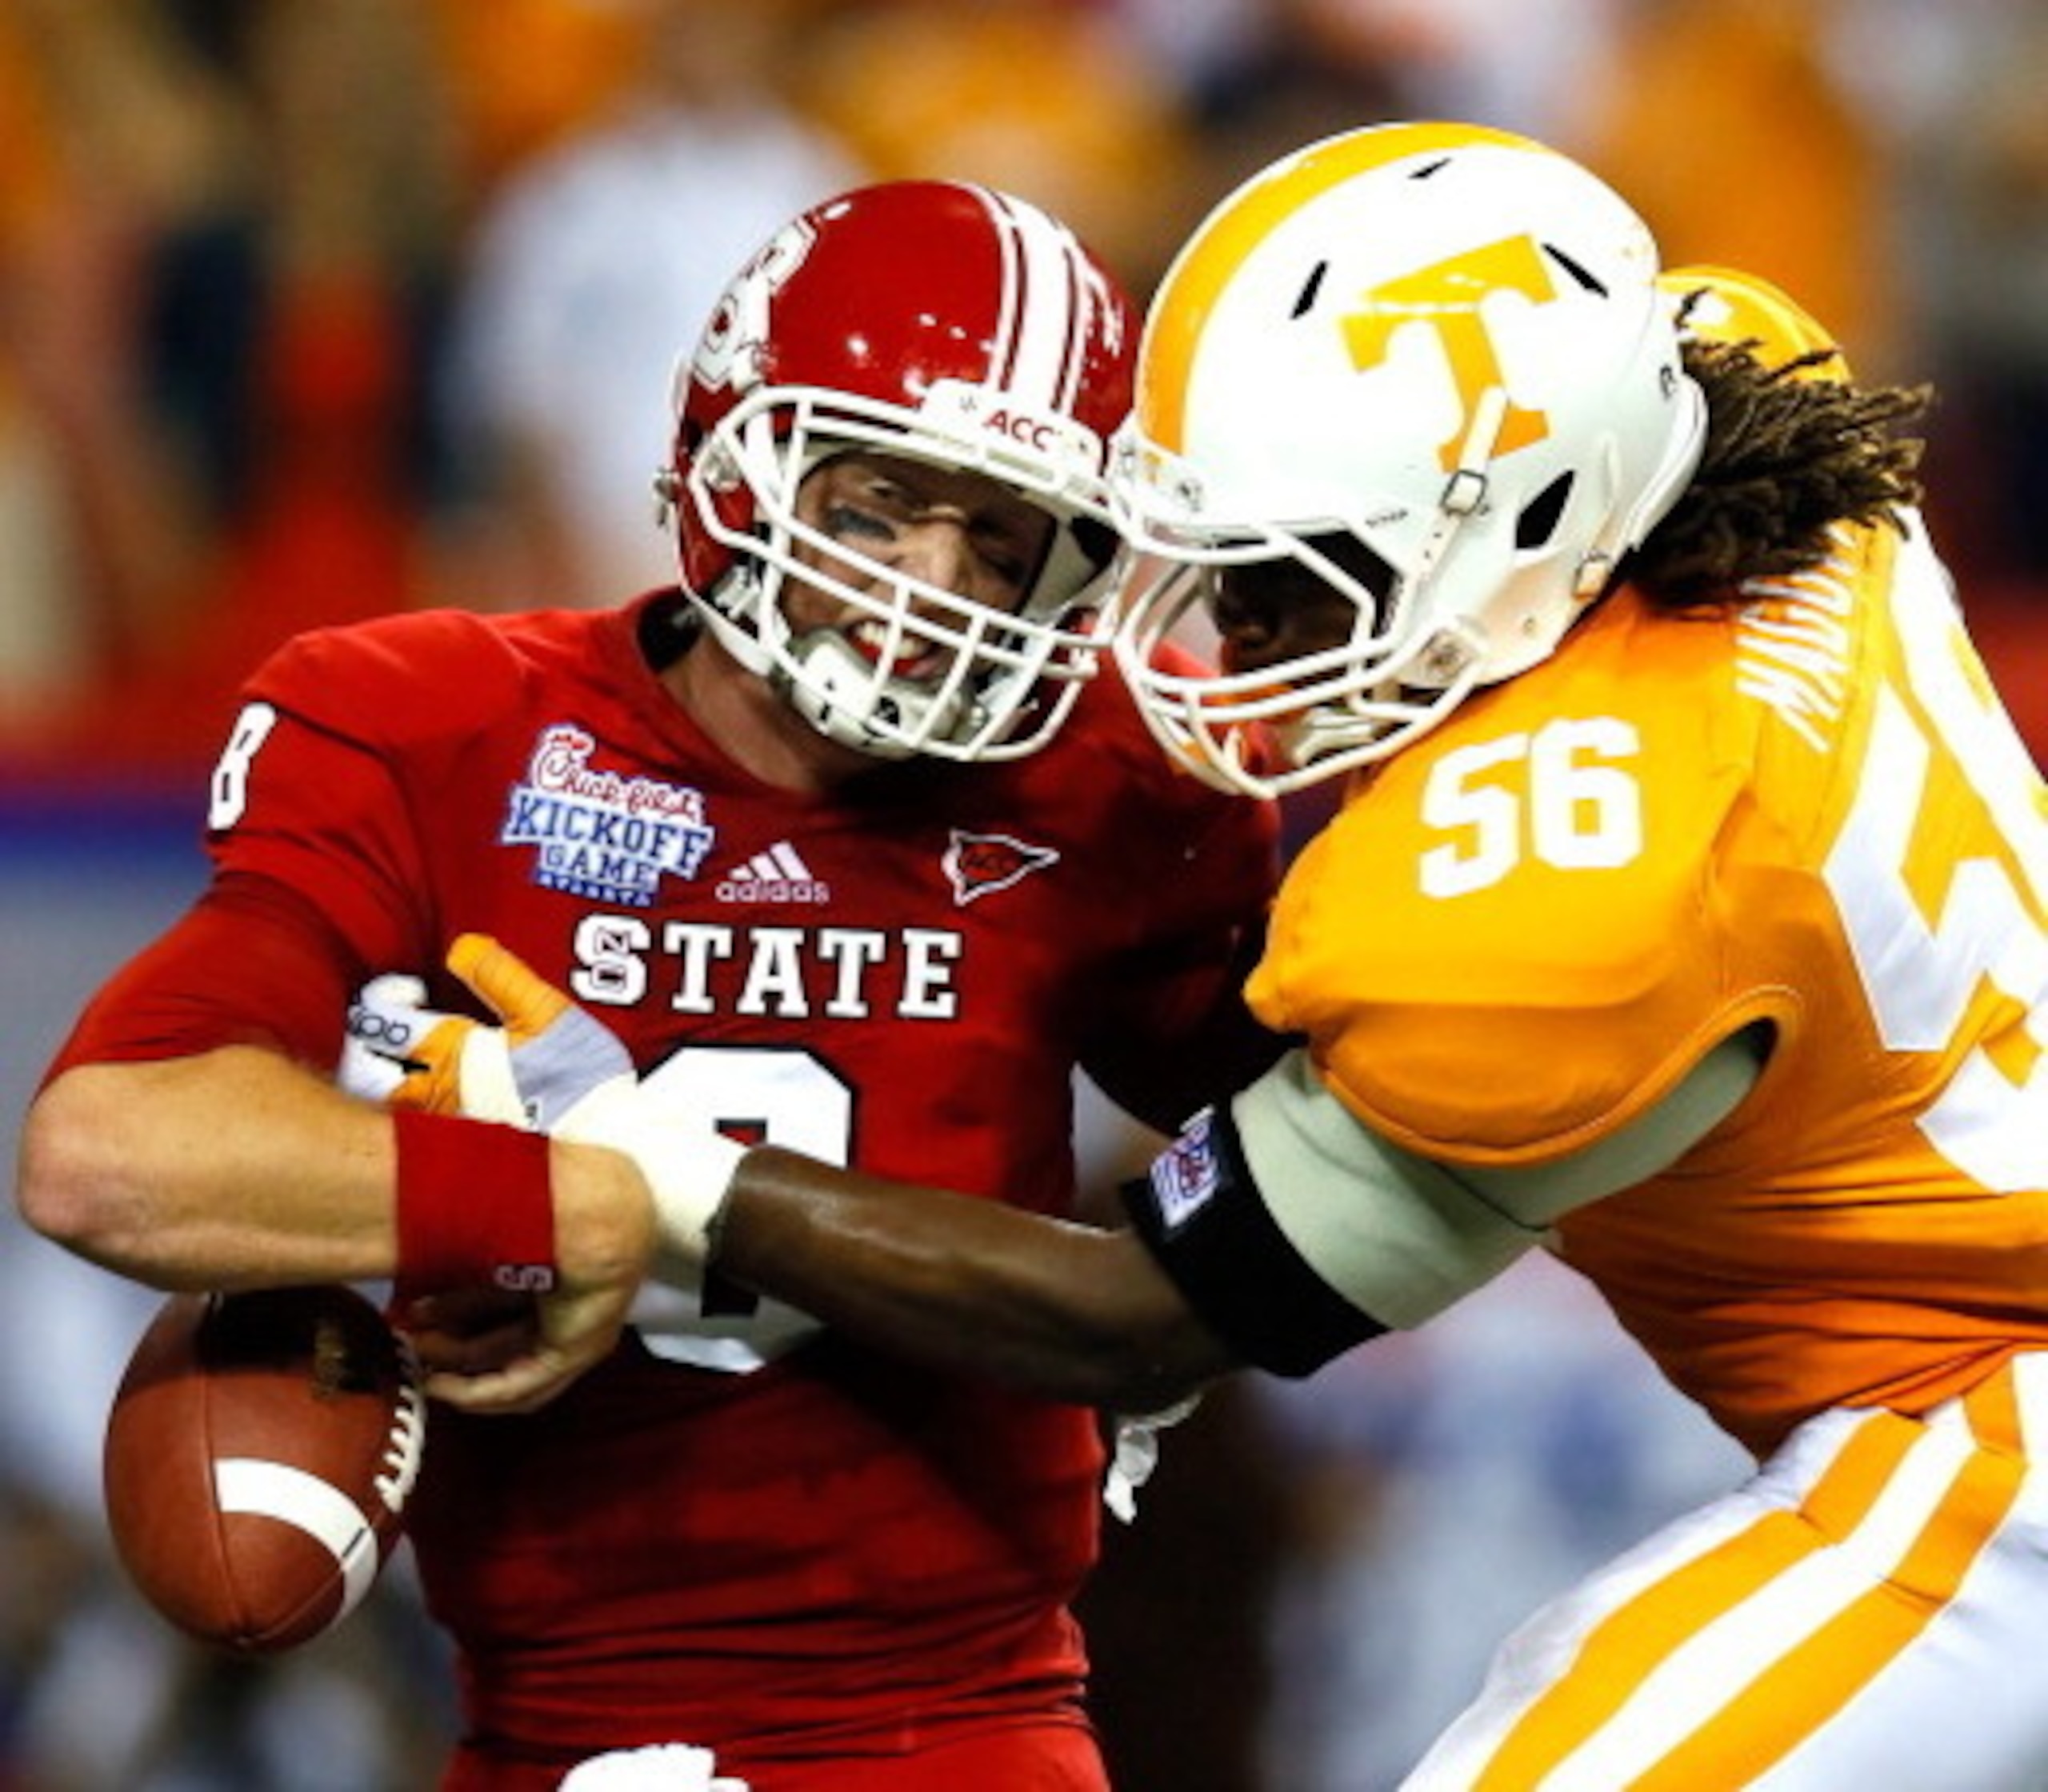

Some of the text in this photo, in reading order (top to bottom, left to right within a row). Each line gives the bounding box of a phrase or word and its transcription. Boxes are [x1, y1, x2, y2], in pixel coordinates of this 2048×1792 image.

[1341, 233, 1558, 474] T
[982, 409, 1055, 452] ACC
[208, 701, 277, 832] 8
[1418, 715, 1644, 898] 56
[512, 794, 710, 870] KICKOFF
[546, 844, 658, 884] GAME
[714, 878, 830, 906] adidas
[569, 914, 963, 1018] STATE
